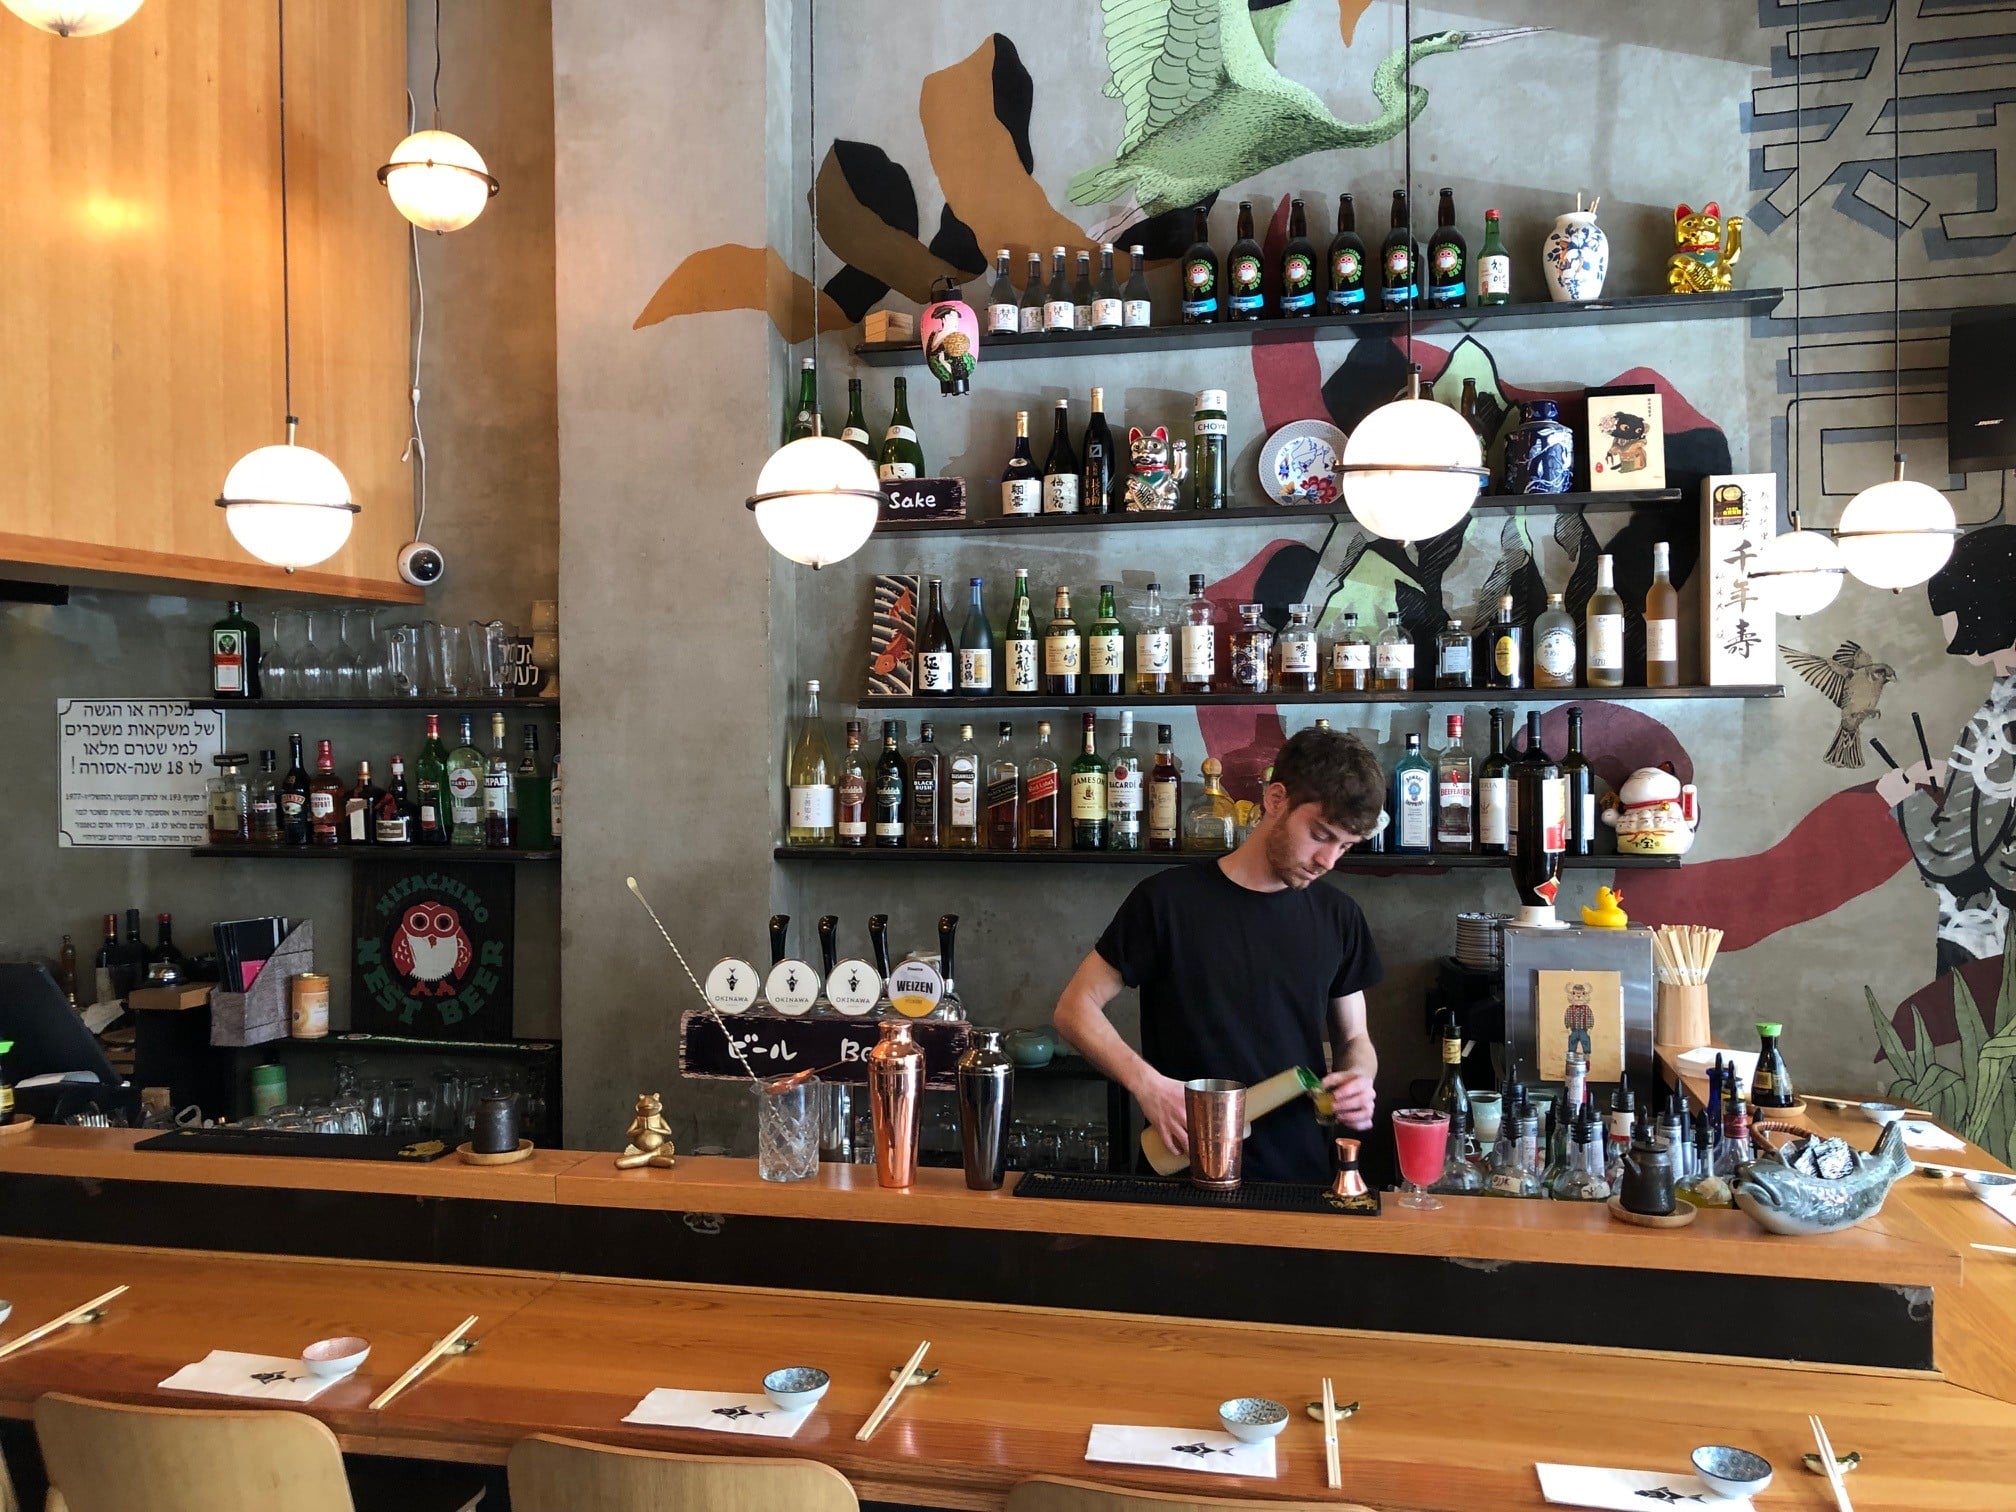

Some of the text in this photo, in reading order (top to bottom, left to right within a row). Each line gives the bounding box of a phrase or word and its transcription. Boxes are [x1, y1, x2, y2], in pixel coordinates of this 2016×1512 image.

[1197, 422, 1226, 432] CHOYA
[888, 491, 937, 510] Sake
[1723, 539, 1762, 659] 千年寿
[84, 704, 195, 717] מכירה או הגשה
[65, 721, 215, 739] של משקאות משכרים
[83, 741, 198, 755] למי שטרם מלאו
[167, 760, 184, 775] 18
[189, 760, 203, 775] לו
[484, 776, 509, 787] MPARI
[1073, 776, 1105, 786] JAMESON
[1441, 788, 1471, 797] BEEFEATER
[376, 872, 489, 924] HITACHINO
[356, 936, 504, 1025] NEST BEER
[896, 980, 934, 994] WEIZEN
[728, 1033, 799, 1061] ビール
